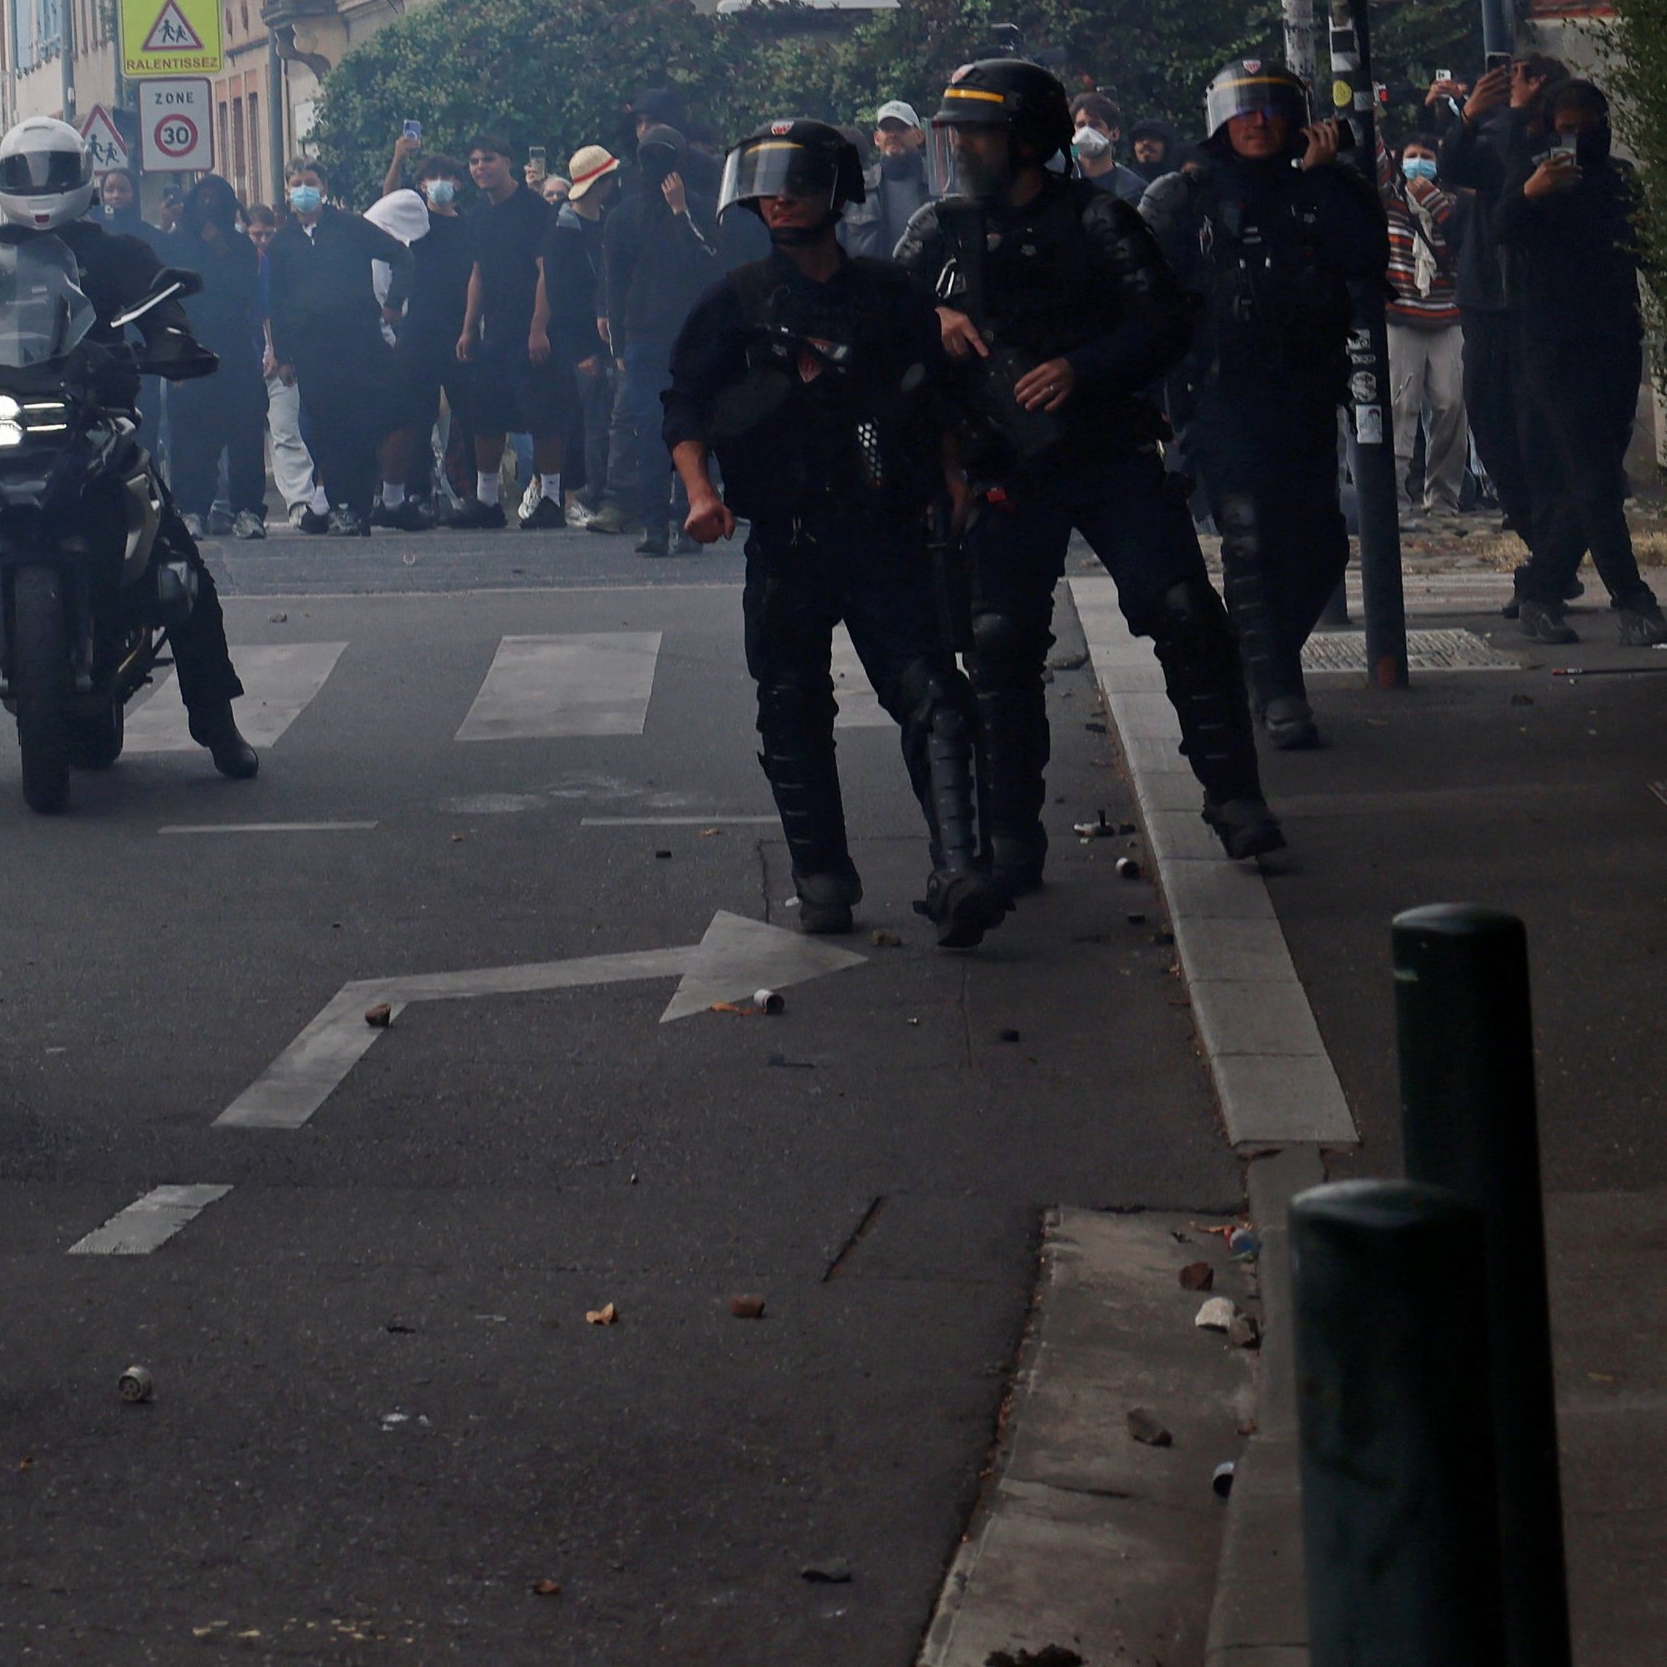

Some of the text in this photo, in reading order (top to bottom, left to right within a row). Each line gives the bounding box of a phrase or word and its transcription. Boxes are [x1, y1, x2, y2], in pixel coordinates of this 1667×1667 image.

[126, 57, 218, 71] RALENTISSEZ
[154, 92, 194, 105] ZONE
[163, 127, 189, 145] 30
